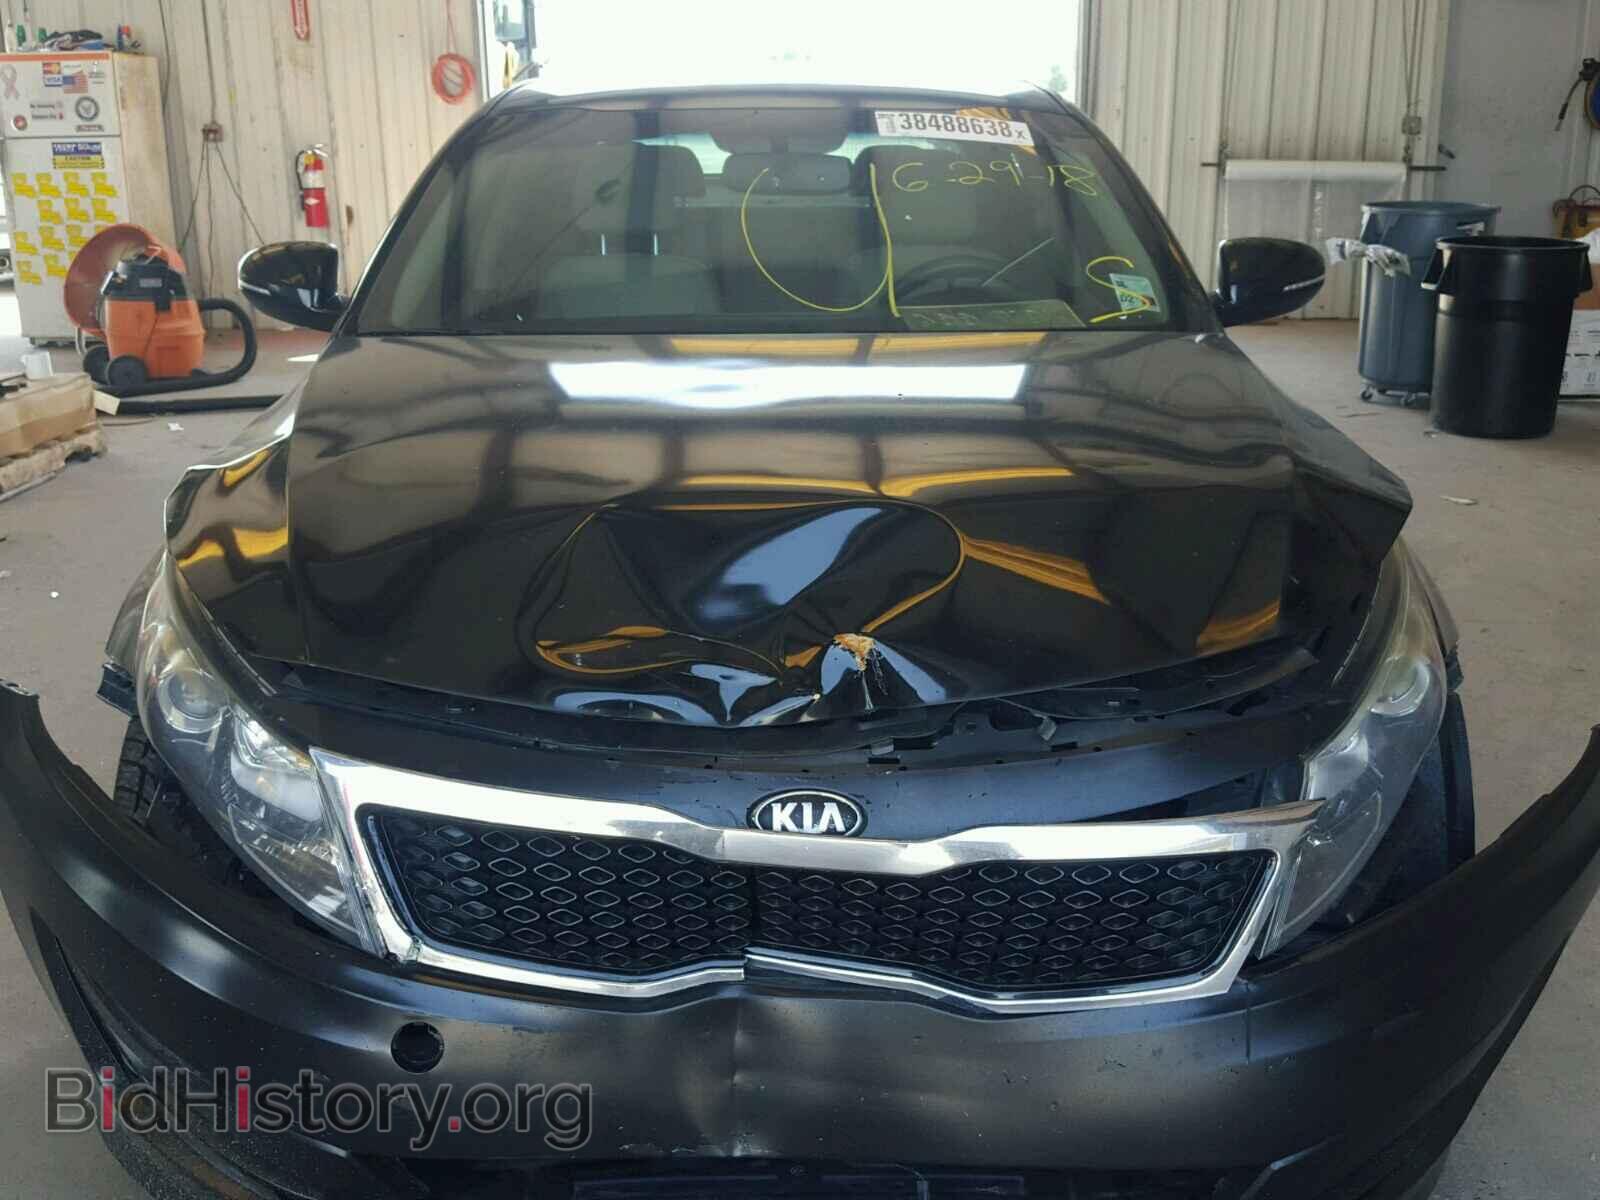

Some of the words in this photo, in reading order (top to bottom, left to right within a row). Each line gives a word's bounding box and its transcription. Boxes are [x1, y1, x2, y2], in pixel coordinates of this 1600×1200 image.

[899, 112, 1013, 138] 38488638
[892, 160, 1098, 197] 6-29-18
[770, 801, 847, 834] KIA
